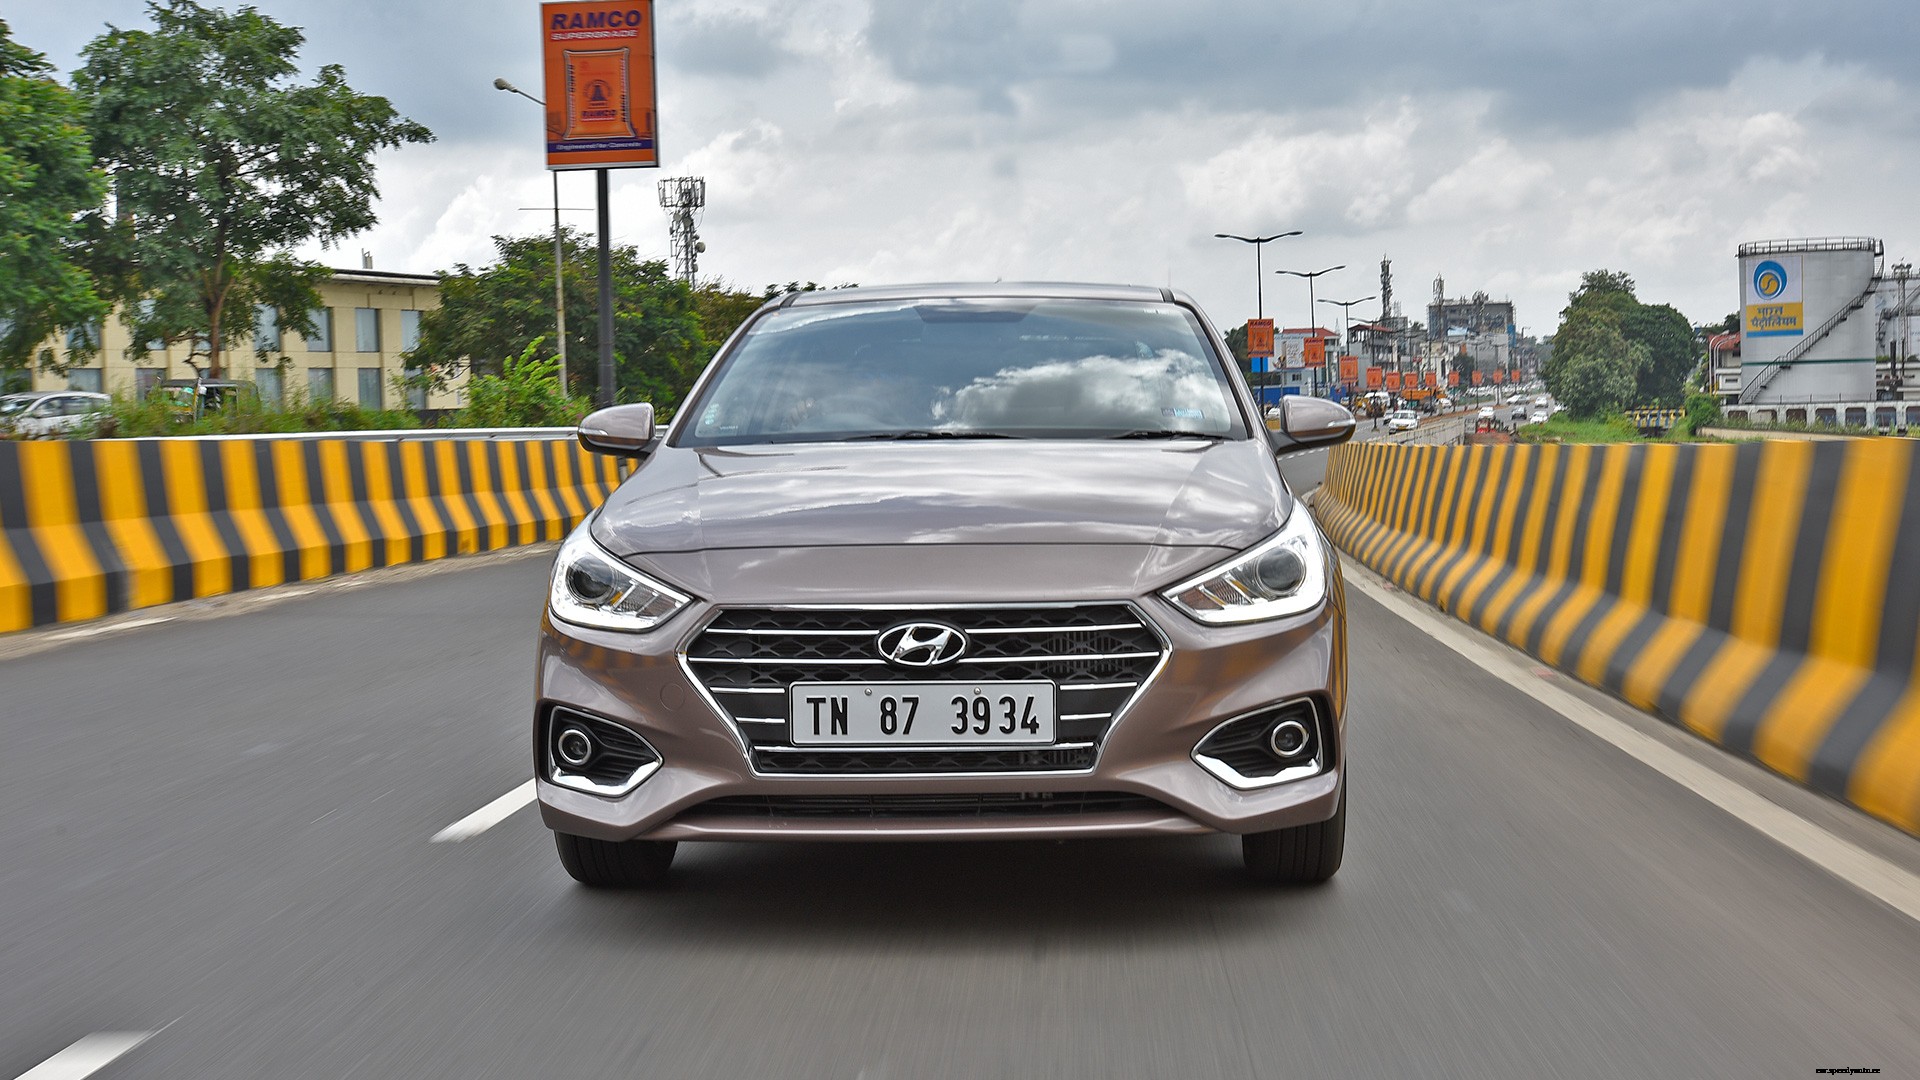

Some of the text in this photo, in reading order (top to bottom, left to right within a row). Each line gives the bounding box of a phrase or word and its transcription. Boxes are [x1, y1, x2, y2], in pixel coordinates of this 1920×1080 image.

[551, 10, 641, 30] RAMCO
[551, 30, 638, 40] SUPERGRADE
[806, 696, 1040, 736] TN 87 3934
